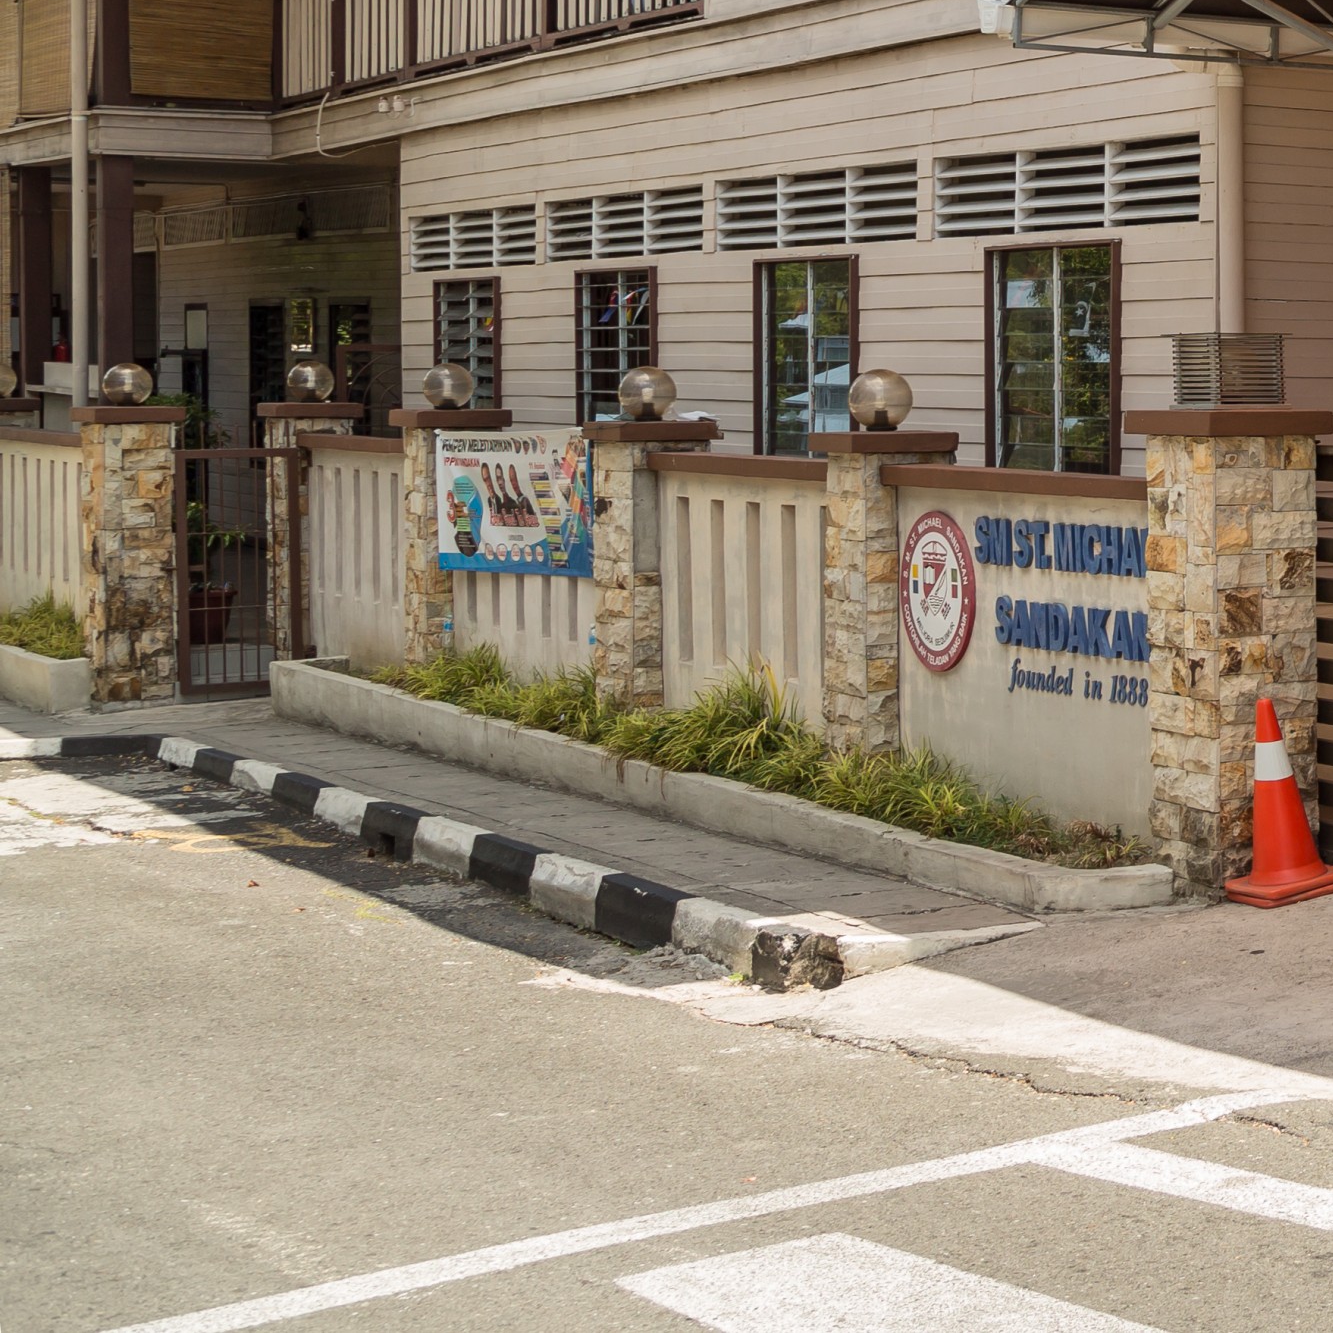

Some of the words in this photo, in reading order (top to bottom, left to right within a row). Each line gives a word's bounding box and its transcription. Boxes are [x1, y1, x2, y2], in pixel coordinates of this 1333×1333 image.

[918, 518, 942, 534] MICHAEL
[946, 527, 968, 585] SANDAKAN
[974, 516, 1012, 566] SM
[1014, 519, 1052, 569] ST.
[904, 604, 926, 659] CONTOHILAH
[927, 652, 948, 666] TELADAN
[949, 636, 961, 657] YANG
[959, 613, 967, 637] BAIK
[995, 595, 1151, 662] SANDAKAN
[1008, 658, 1073, 695] founded
[1084, 672, 1102, 700] in
[1109, 675, 1148, 707] 1888
